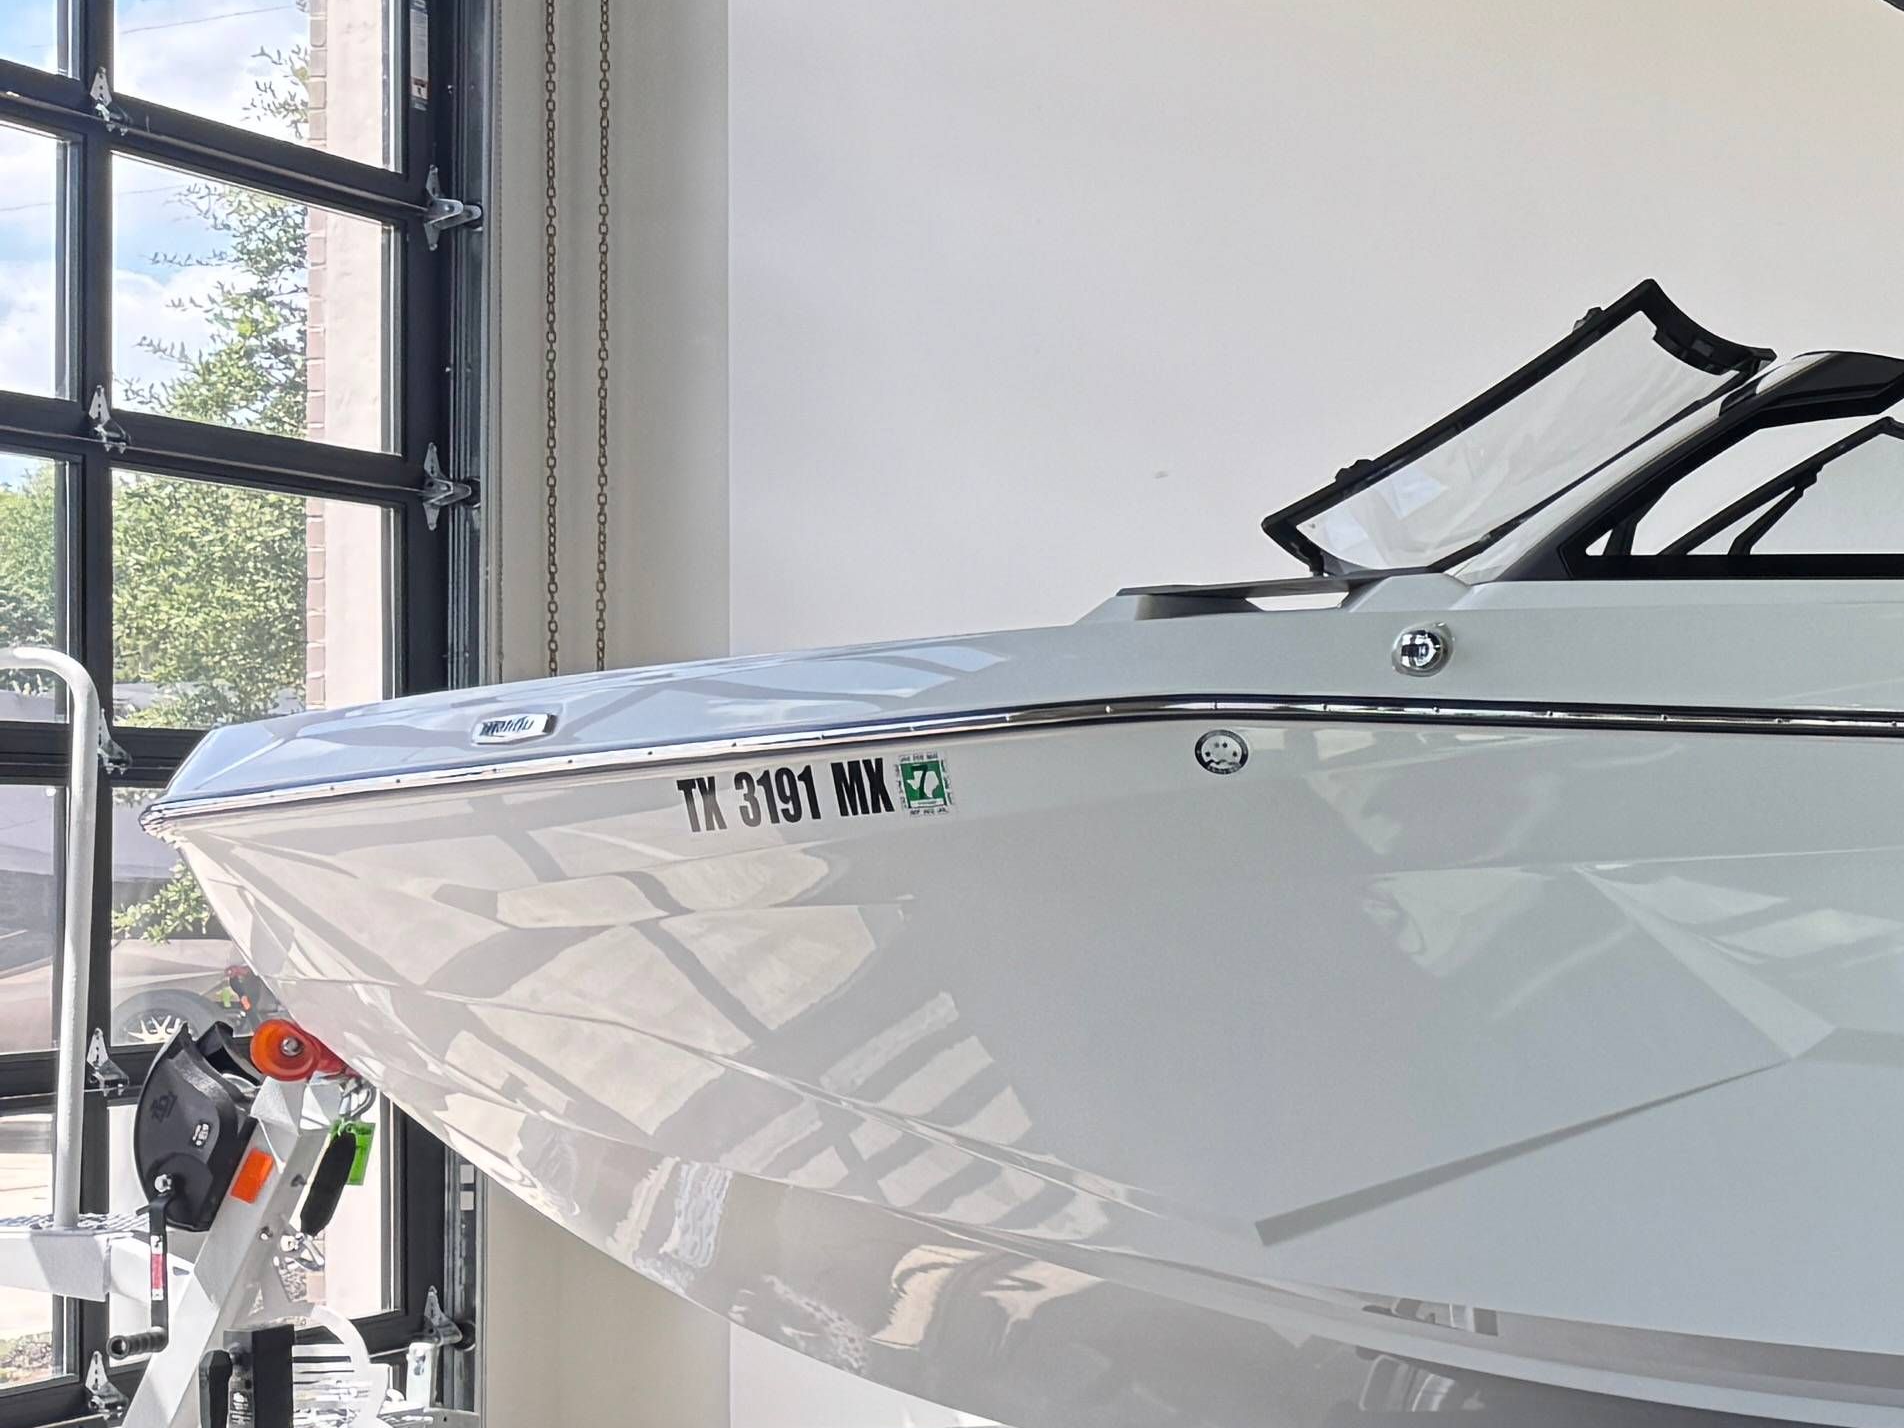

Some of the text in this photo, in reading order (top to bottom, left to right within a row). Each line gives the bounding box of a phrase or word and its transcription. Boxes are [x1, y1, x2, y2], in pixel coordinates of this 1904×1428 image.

[676, 775, 728, 833] TX
[733, 764, 821, 828] 3191
[830, 757, 895, 817] MX
